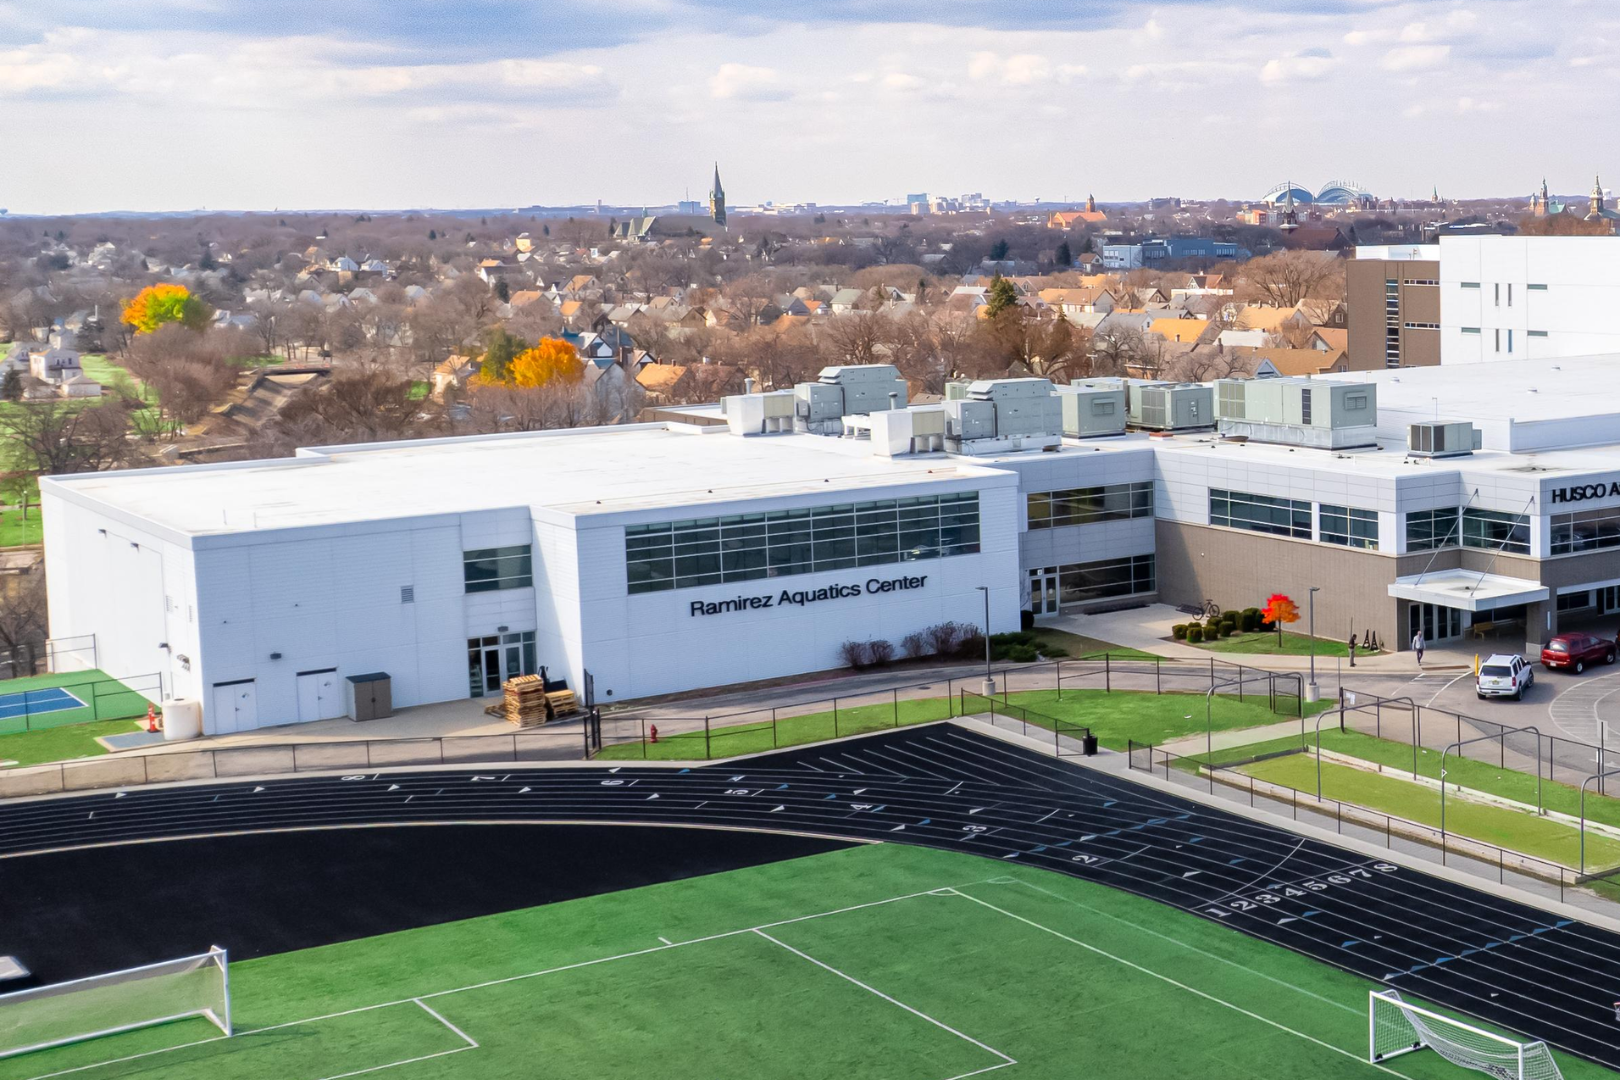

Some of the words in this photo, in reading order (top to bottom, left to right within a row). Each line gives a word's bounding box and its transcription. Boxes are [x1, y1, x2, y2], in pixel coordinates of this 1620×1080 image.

[1552, 483, 1606, 503] HUSCO
[690, 594, 773, 617] Ramirez
[778, 583, 861, 606] Aquatics
[866, 575, 928, 594] Center
[1205, 908, 1232, 917] 1
[1230, 901, 1258, 911] 2
[1255, 894, 1281, 904] 3
[1285, 887, 1307, 897] 4
[1302, 880, 1328, 891] 5
[1327, 875, 1352, 884] 6
[1348, 868, 1373, 878] 7
[1373, 863, 1399, 873] 8
